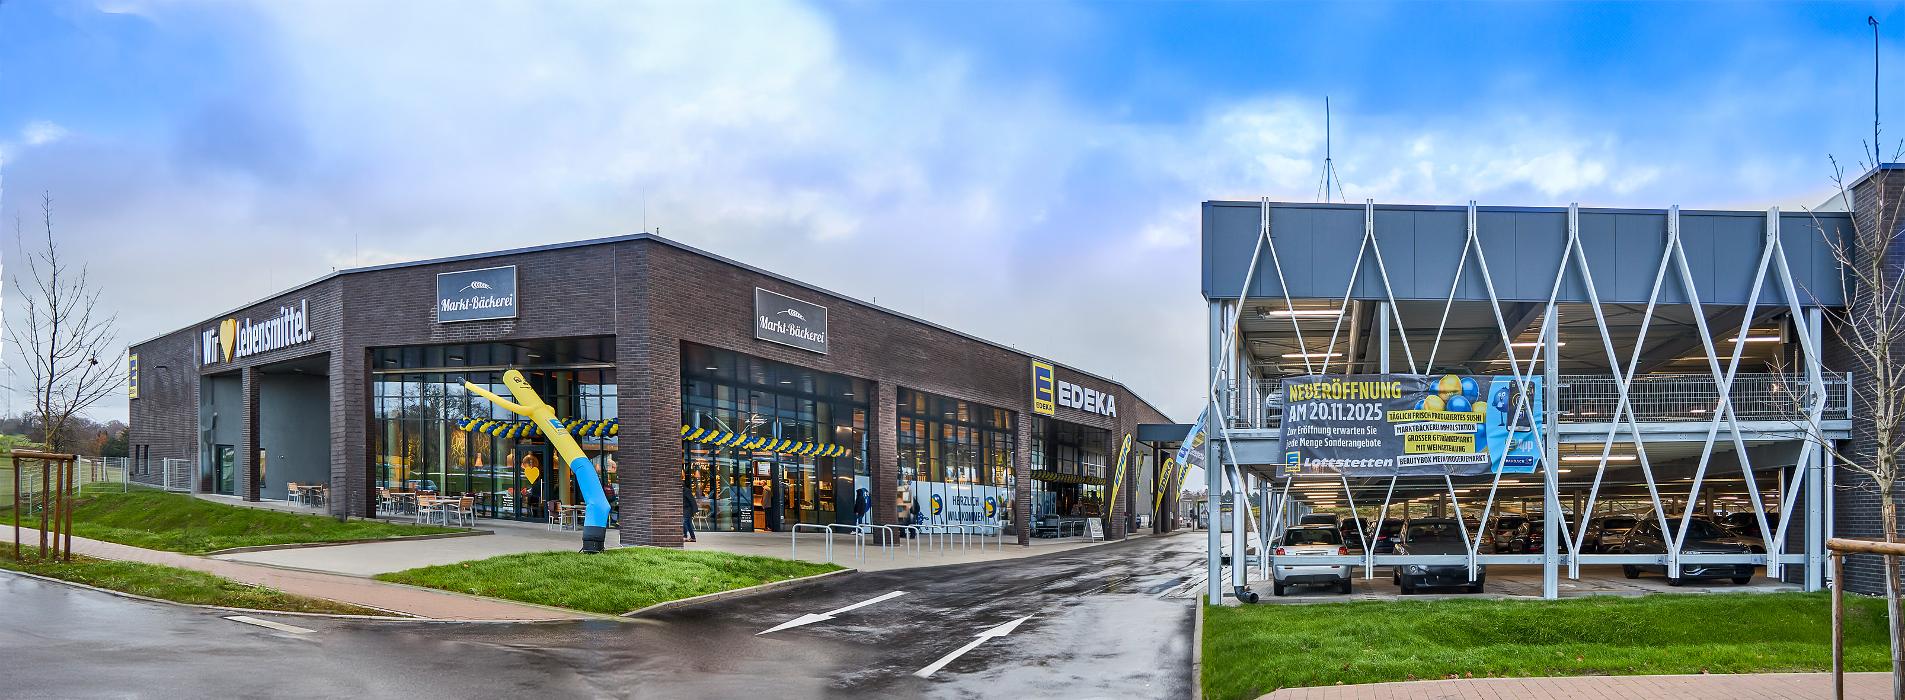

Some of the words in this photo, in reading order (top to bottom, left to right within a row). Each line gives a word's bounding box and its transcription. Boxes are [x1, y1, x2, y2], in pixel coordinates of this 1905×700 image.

[440, 293, 513, 312] Markt-Bäckerei
[202, 328, 220, 365] Wir
[236, 299, 313, 358] Lebensmittel.
[759, 315, 825, 344] Markt-Bäckerei
[1289, 378, 1401, 402] NEUERÖFFNUNG
[1057, 379, 1117, 418] EDEKA
[1035, 401, 1053, 412] EDEKA
[1288, 403, 1307, 422] AM
[1309, 401, 1383, 421] 20.11.2025
[1389, 411, 1412, 421] TÄGLICH
[1412, 411, 1432, 420] FRISCH
[1466, 414, 1483, 422] SUSHI
[1287, 427, 1297, 436] Zur
[1297, 425, 1332, 436] Eröffnung
[1332, 426, 1365, 435] erwarten
[1366, 426, 1378, 435] Sie
[1286, 439, 1299, 449] jede
[1299, 437, 1323, 449] Menge
[1324, 437, 1382, 449] Sonderangebote
[1407, 434, 1432, 442] GROSSER
[1517, 438, 1534, 453] App
[1303, 457, 1394, 468] Lottstetten
[1399, 456, 1432, 465] BEAUTYBOX
[1158, 461, 1173, 494] EDEKA
[952, 495, 980, 507] HERZLICH
[947, 510, 985, 522] WILLKOMMEN
